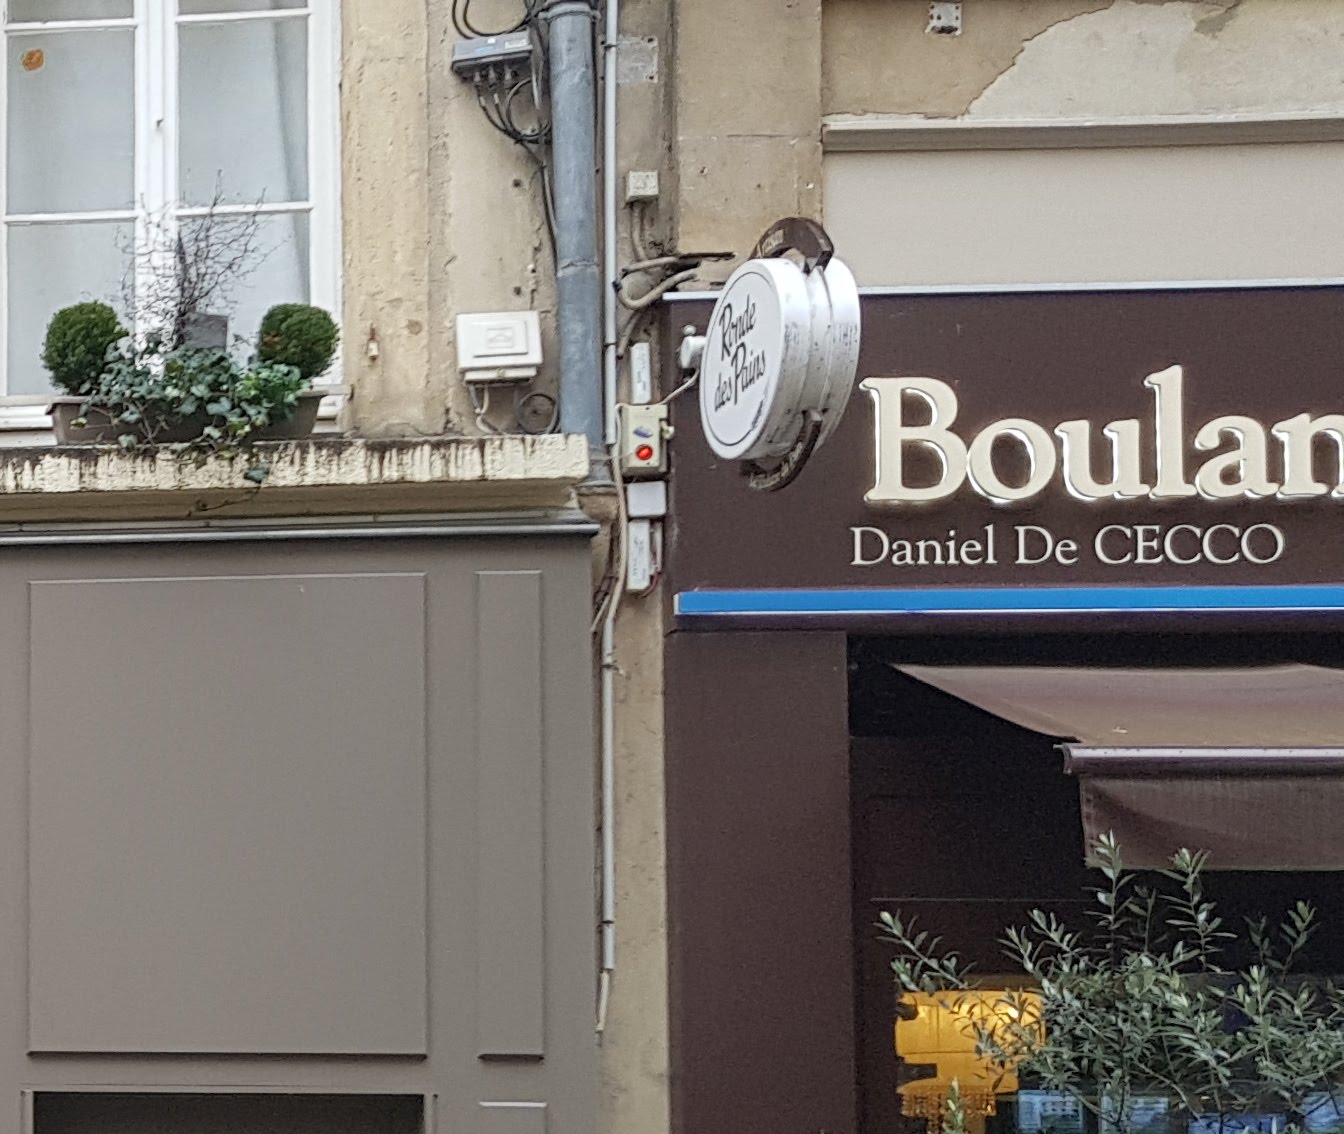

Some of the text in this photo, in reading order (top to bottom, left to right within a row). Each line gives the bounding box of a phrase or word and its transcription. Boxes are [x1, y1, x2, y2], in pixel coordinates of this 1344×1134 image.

[719, 294, 757, 361] Ronde
[714, 342, 766, 412] des Pains
[858, 364, 1344, 502] Boulan
[849, 523, 1286, 565] Daniel De CECCO
